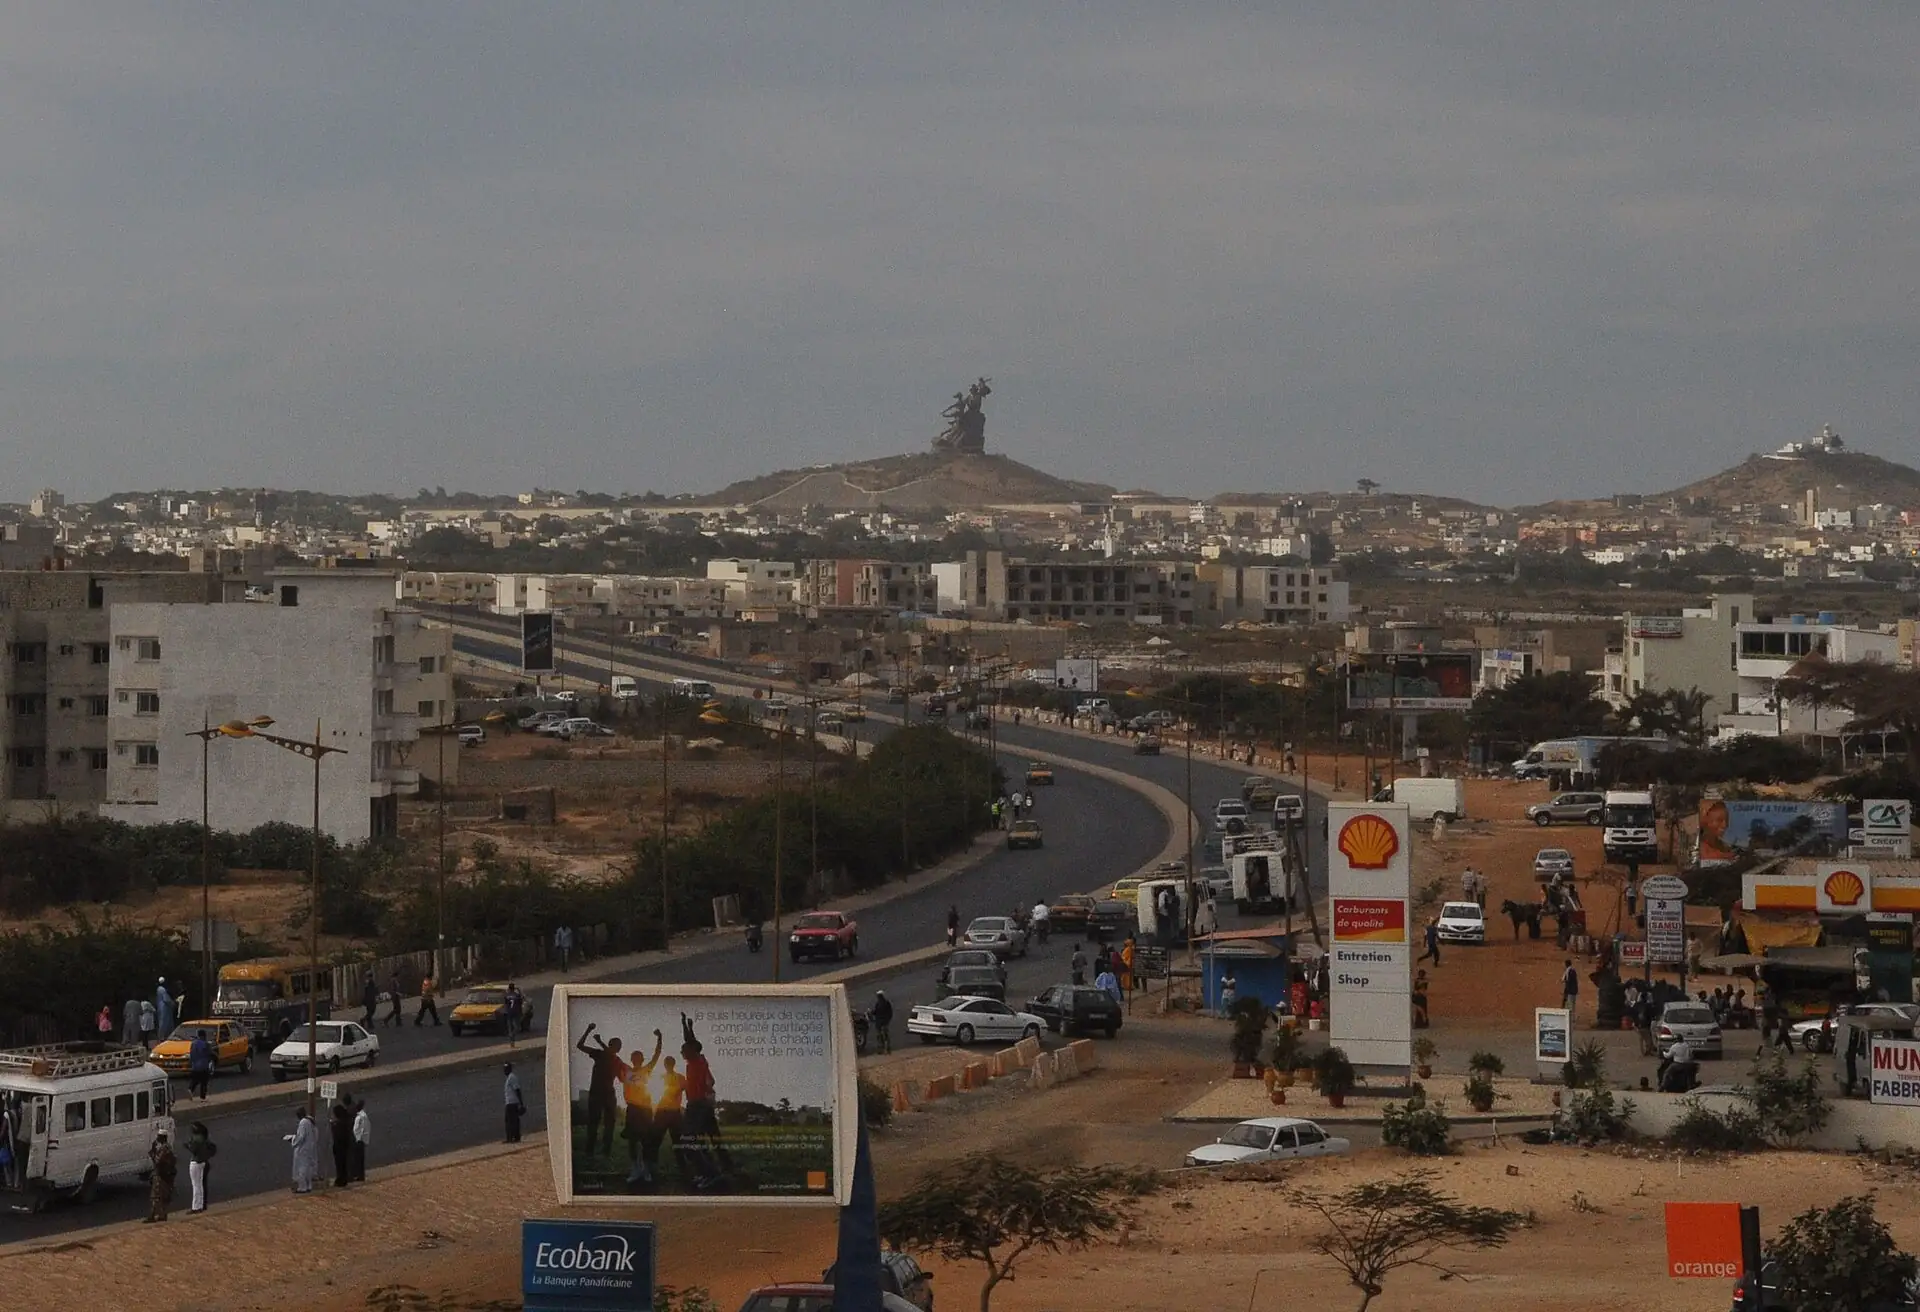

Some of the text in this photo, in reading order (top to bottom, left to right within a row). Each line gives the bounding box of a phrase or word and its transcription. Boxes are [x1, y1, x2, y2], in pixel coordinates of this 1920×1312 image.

[1337, 905, 1389, 914] Carburants
[1337, 918, 1385, 929] de qualité
[1337, 951, 1392, 962] Entretien
[1338, 974, 1370, 987] Shop
[706, 1010, 729, 1020] suis
[731, 1009, 775, 1020] heureux
[777, 1009, 793, 1020] de
[795, 1010, 823, 1020] cette
[710, 1022, 823, 1034] complicité partagée
[714, 1035, 742, 1045] avec
[745, 1035, 767, 1045] eux
[780, 1034, 823, 1046] chaque
[717, 1046, 824, 1057] moment de ma vie
[535, 1234, 637, 1271] Ecobank
[1673, 1262, 1737, 1277] orange
[532, 1275, 633, 1288] La Banque Panafricaine
